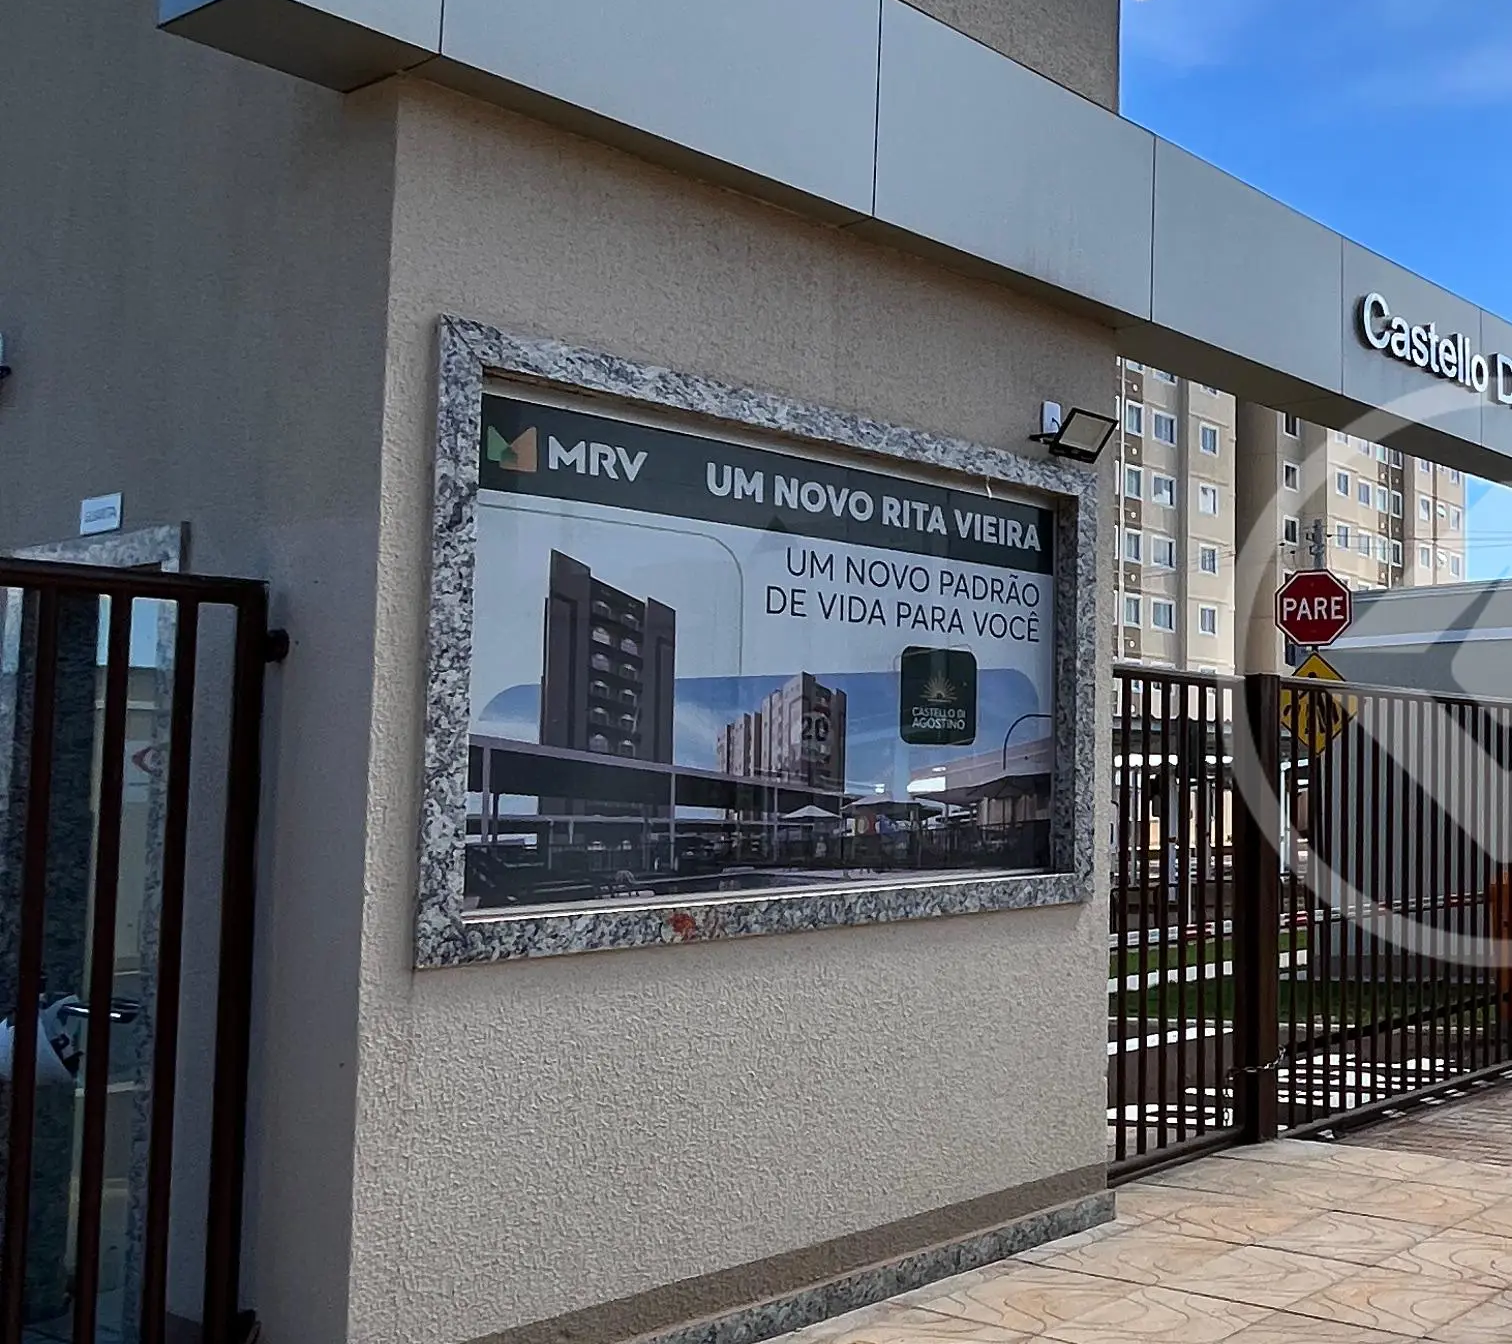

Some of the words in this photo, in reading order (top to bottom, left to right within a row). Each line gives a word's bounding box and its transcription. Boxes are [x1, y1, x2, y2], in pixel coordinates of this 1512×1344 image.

[1363, 292, 1489, 393] Castello
[548, 436, 648, 482] MRV
[706, 462, 764, 503] UM
[774, 474, 874, 522] NOVO
[882, 496, 948, 535] RITA
[954, 509, 1042, 552] VIEIRA
[786, 546, 834, 581] UM
[846, 555, 930, 593] NOVO
[939, 569, 1040, 608] PADRÃO
[766, 585, 808, 617] DE
[818, 591, 887, 626] VIDA
[896, 602, 965, 635] PARA
[973, 611, 1040, 642] VOCÊ
[1282, 596, 1344, 621] PARE
[911, 717, 966, 730] AGOSTINO
[912, 707, 956, 718] CASTELLO
